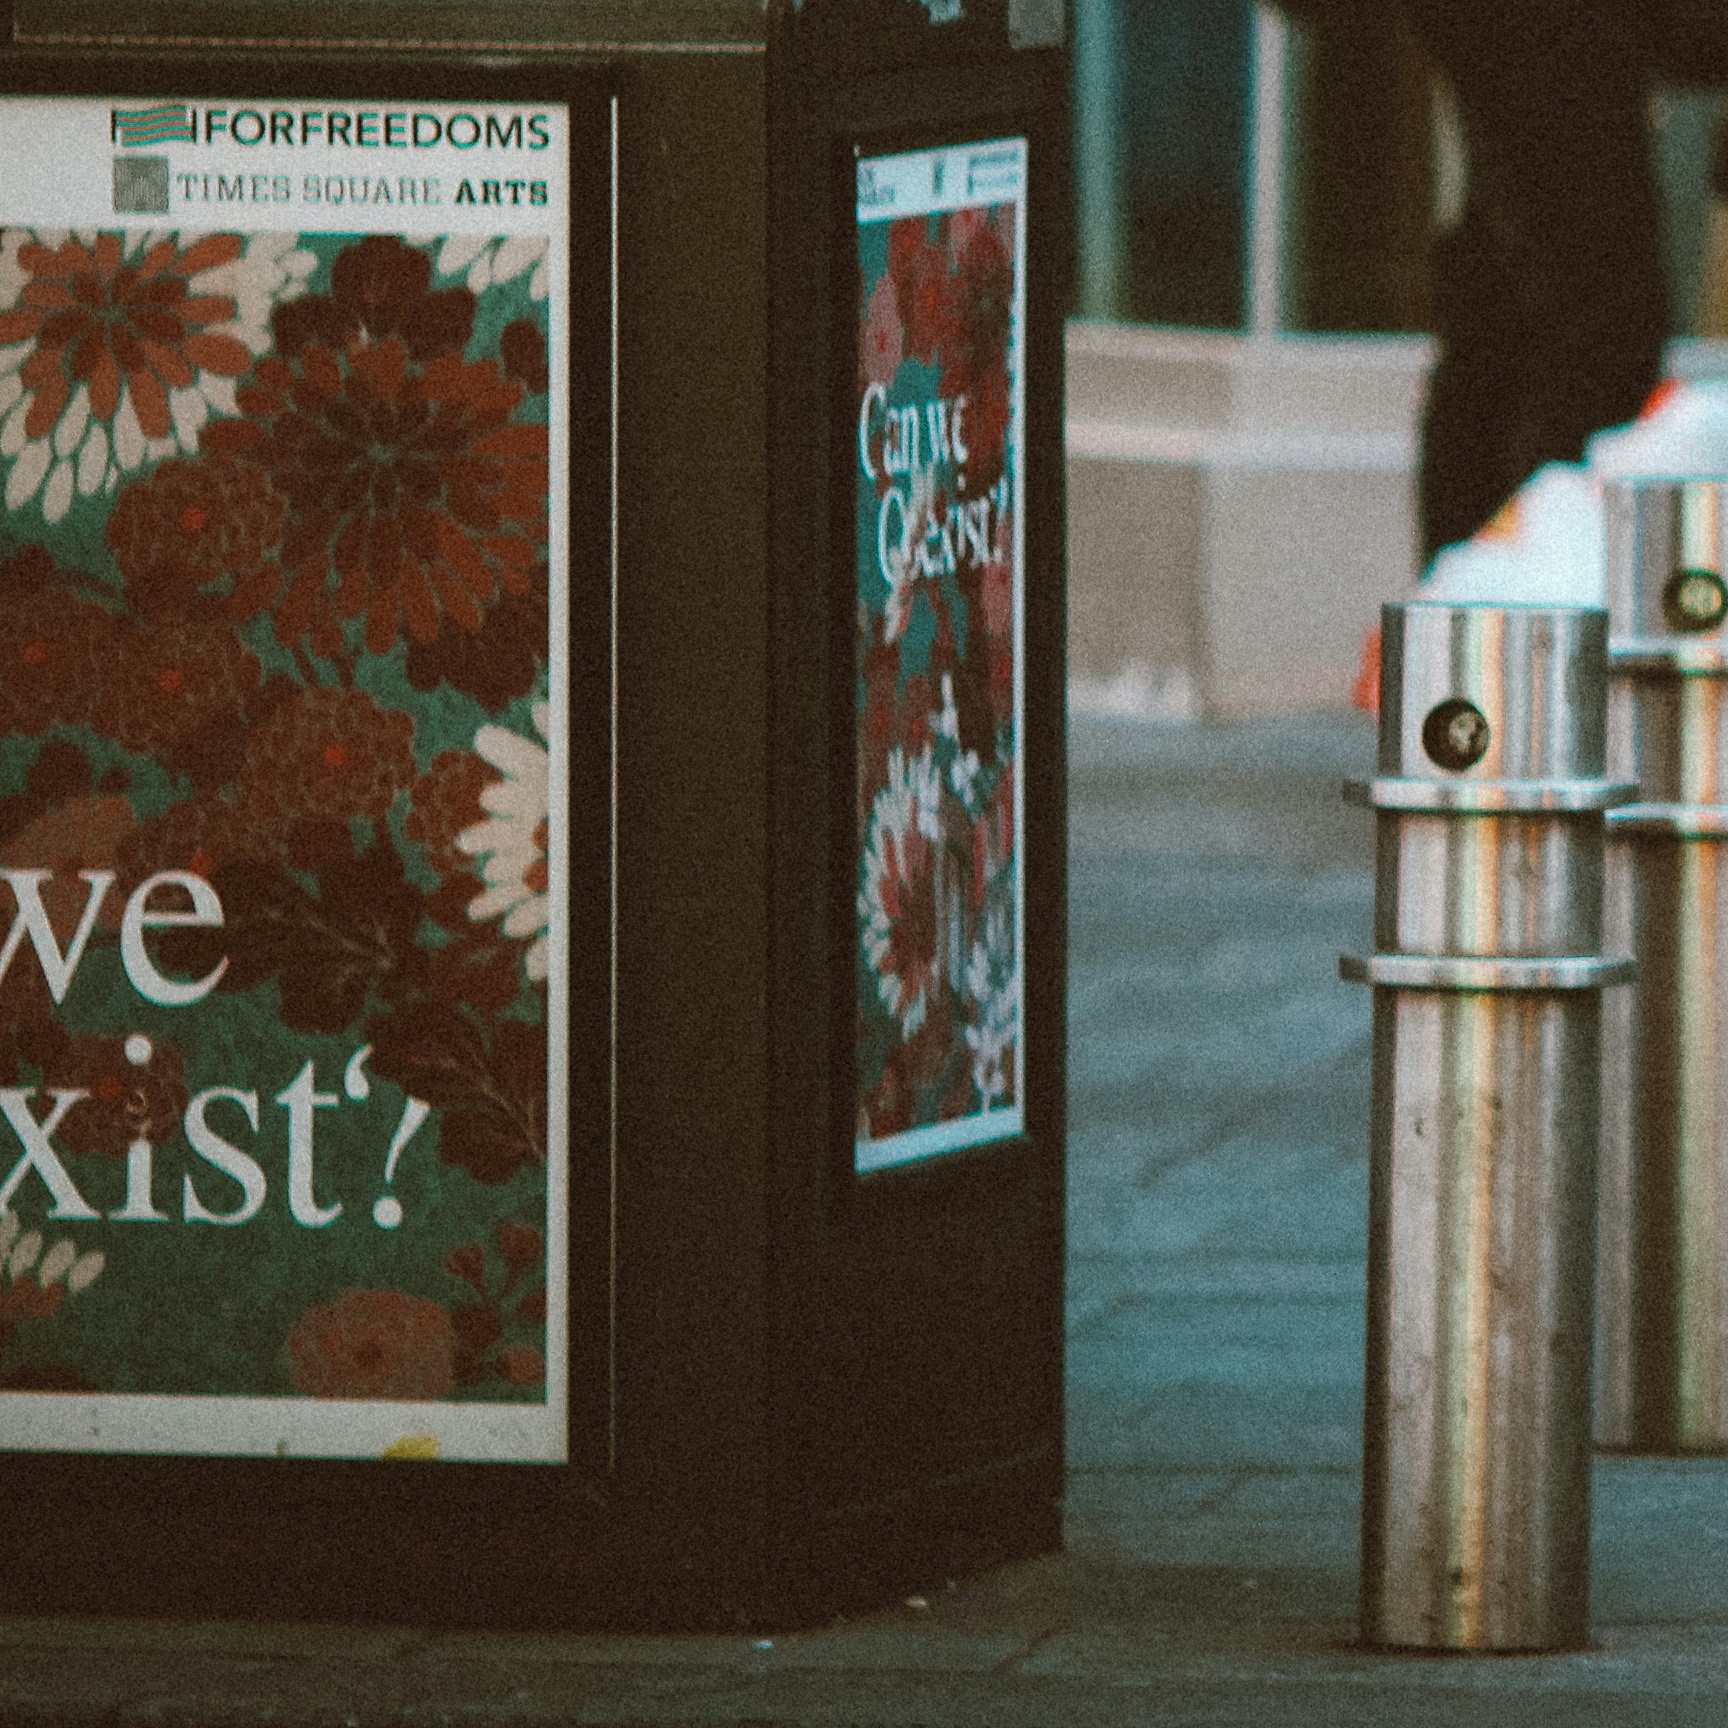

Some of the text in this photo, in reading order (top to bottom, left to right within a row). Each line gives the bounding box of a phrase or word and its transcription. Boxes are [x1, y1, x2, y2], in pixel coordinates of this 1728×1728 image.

[204, 109, 551, 151] FORFREEDOMS
[176, 173, 550, 207] TIMES SQUARE ARTS
[0, 869, 229, 1007] we
